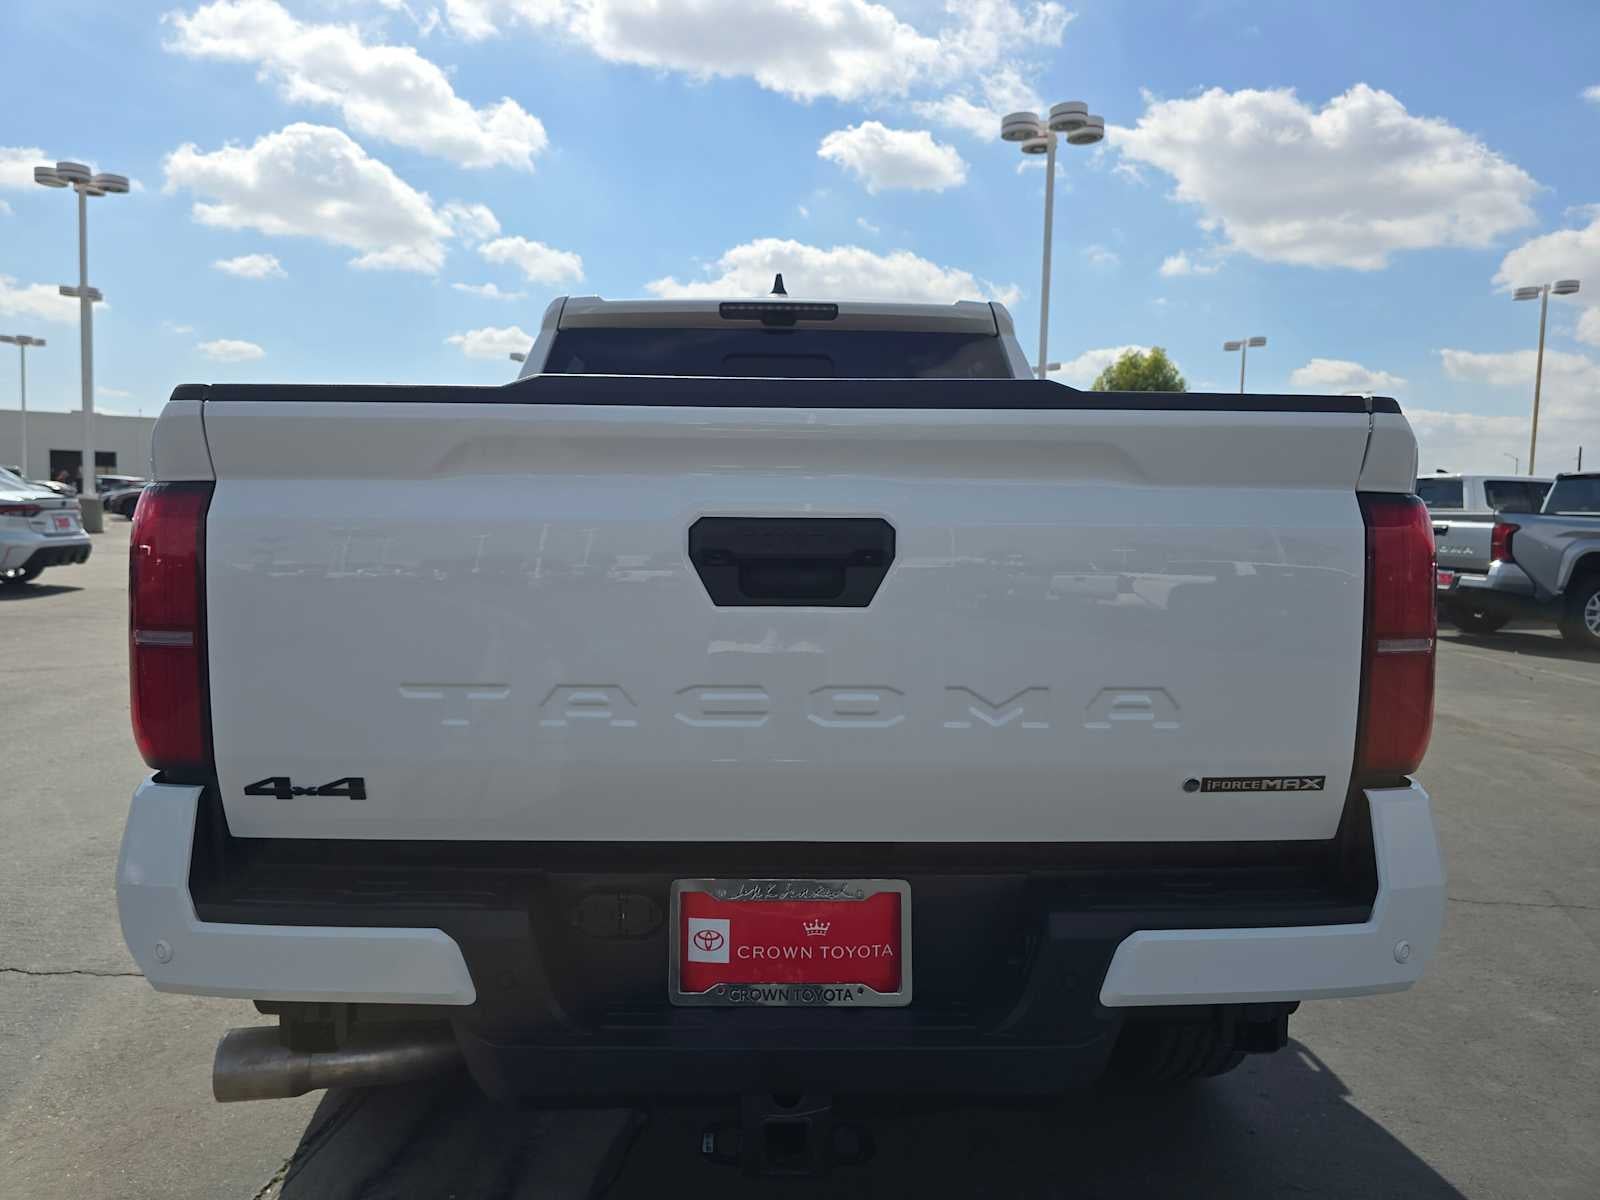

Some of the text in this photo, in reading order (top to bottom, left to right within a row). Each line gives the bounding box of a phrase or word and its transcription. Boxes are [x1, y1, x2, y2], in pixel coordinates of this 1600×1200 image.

[398, 682, 1182, 730] TACOMA
[737, 943, 894, 960] CROWN TOYOTA
[729, 987, 854, 1002] CROWN TOYOTA
